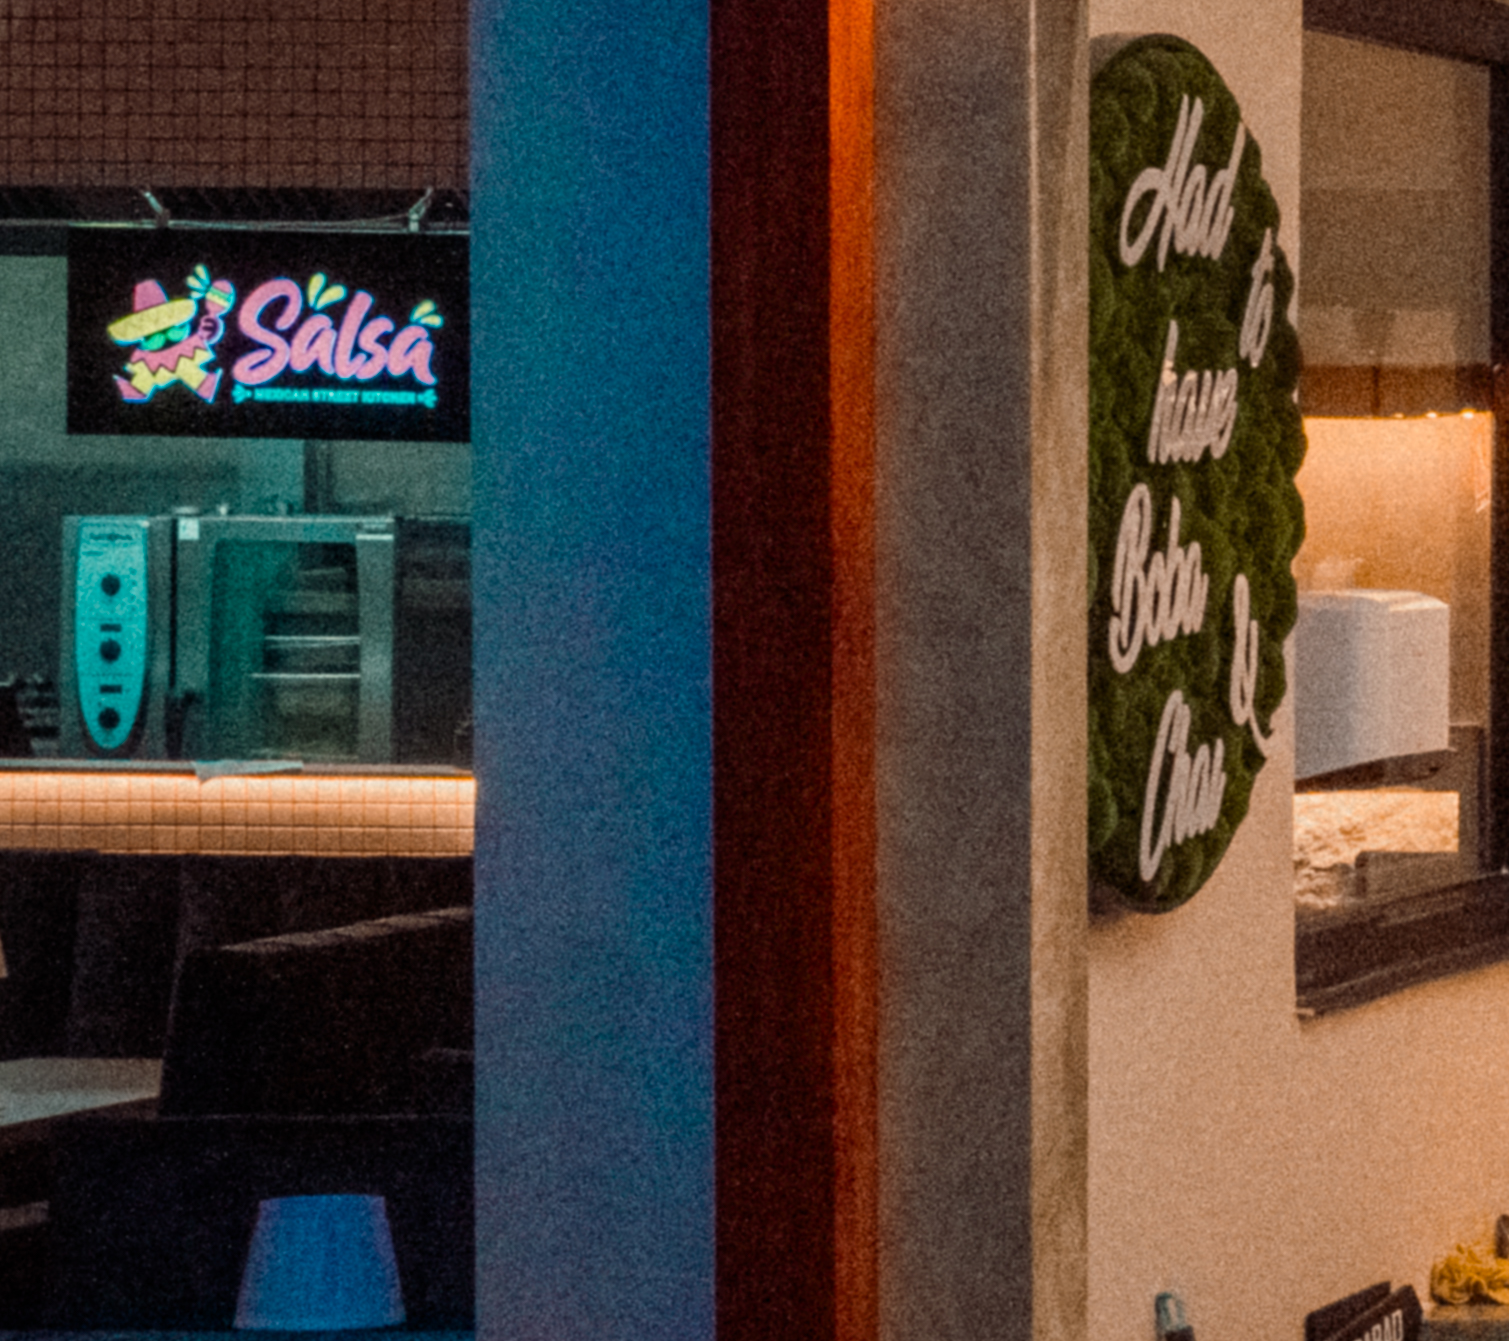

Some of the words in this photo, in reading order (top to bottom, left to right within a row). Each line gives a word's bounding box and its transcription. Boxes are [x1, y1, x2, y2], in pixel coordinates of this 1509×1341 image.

[1119, 93, 1246, 272] Had
[1239, 227, 1275, 368] to
[254, 388, 310, 402] MEXICAN
[312, 389, 359, 403] STREET
[361, 390, 416, 404] KITCHEN
[1147, 319, 1239, 465] have
[1108, 483, 1209, 674] Boba
[1139, 689, 1227, 882] Chai
